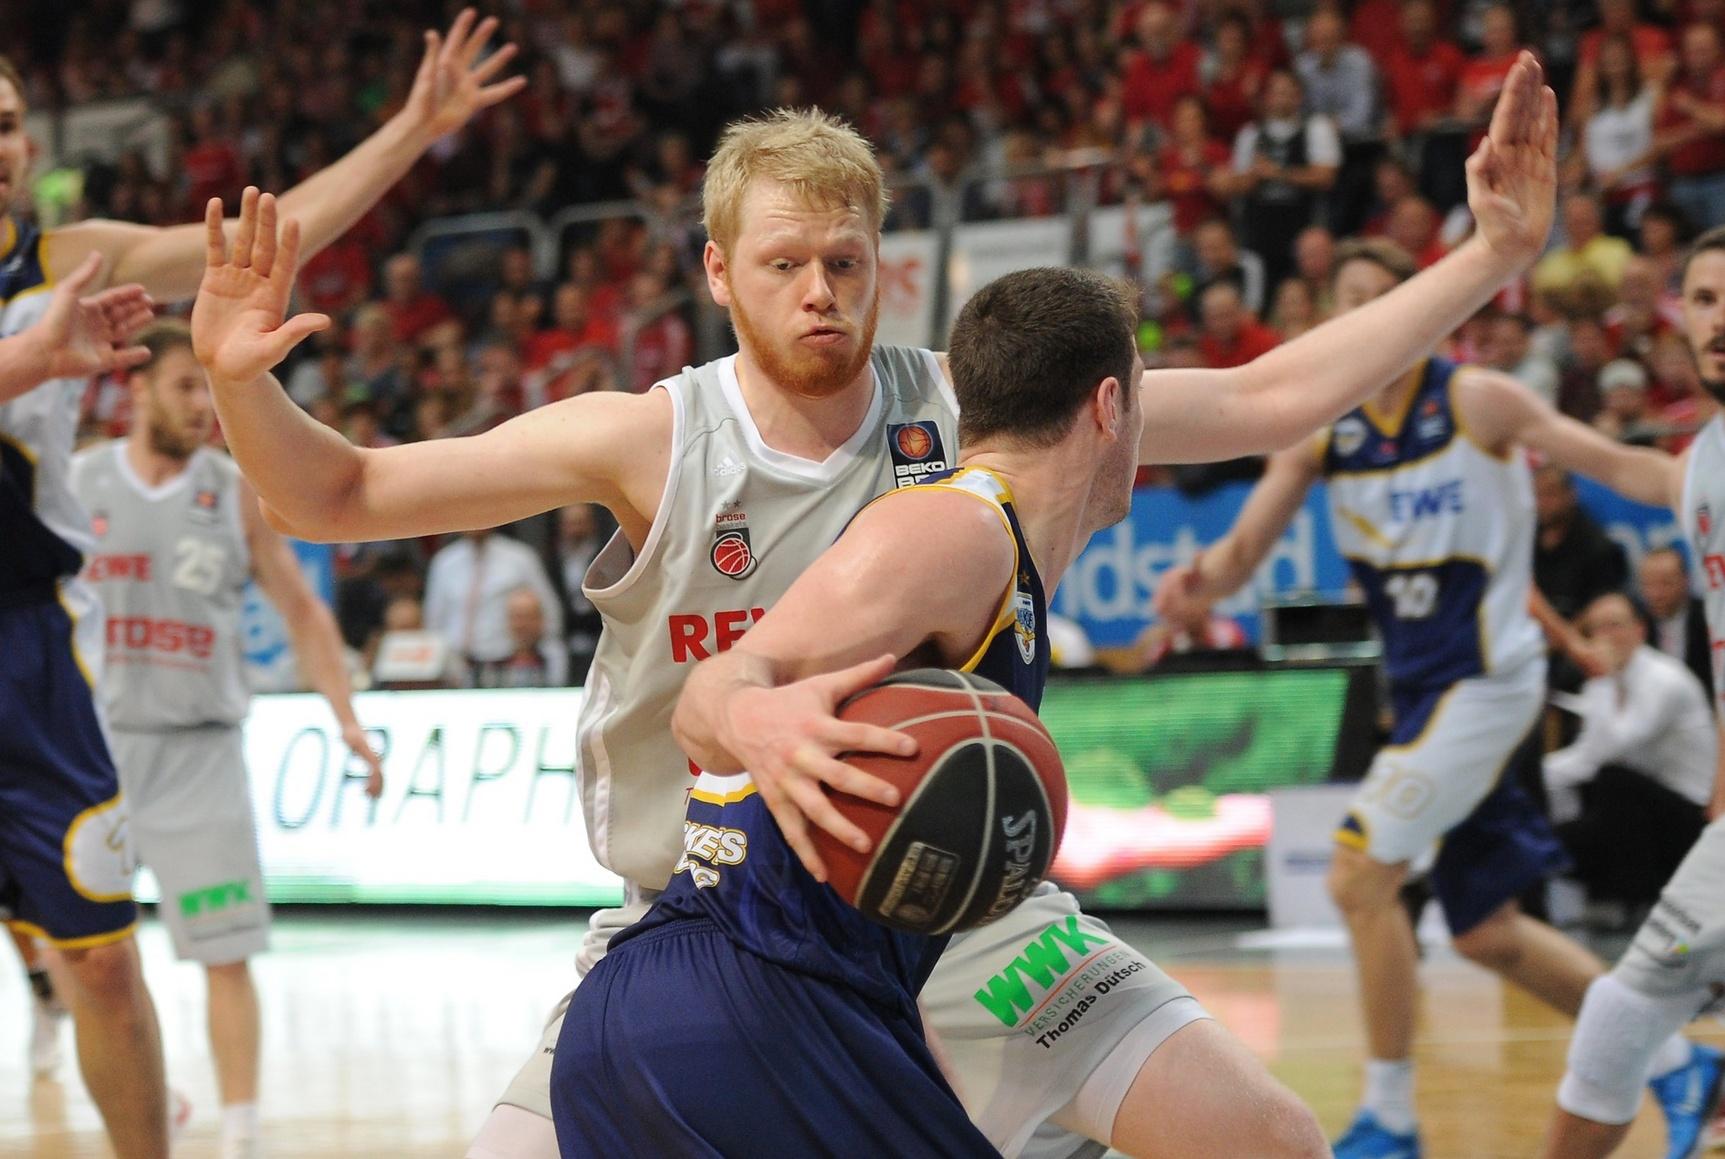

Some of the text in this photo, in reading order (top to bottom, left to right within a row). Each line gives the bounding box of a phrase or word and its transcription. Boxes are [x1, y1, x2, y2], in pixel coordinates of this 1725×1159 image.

[895, 461, 946, 477] BEKO
[715, 512, 747, 524] brose
[1384, 573, 1440, 619] 10
[668, 608, 766, 663] RE
[974, 915, 1110, 1028] WWK
[1023, 949, 1131, 1038] VERSICHERUNGEN
[1035, 960, 1146, 1050] Thomas Dütsch
